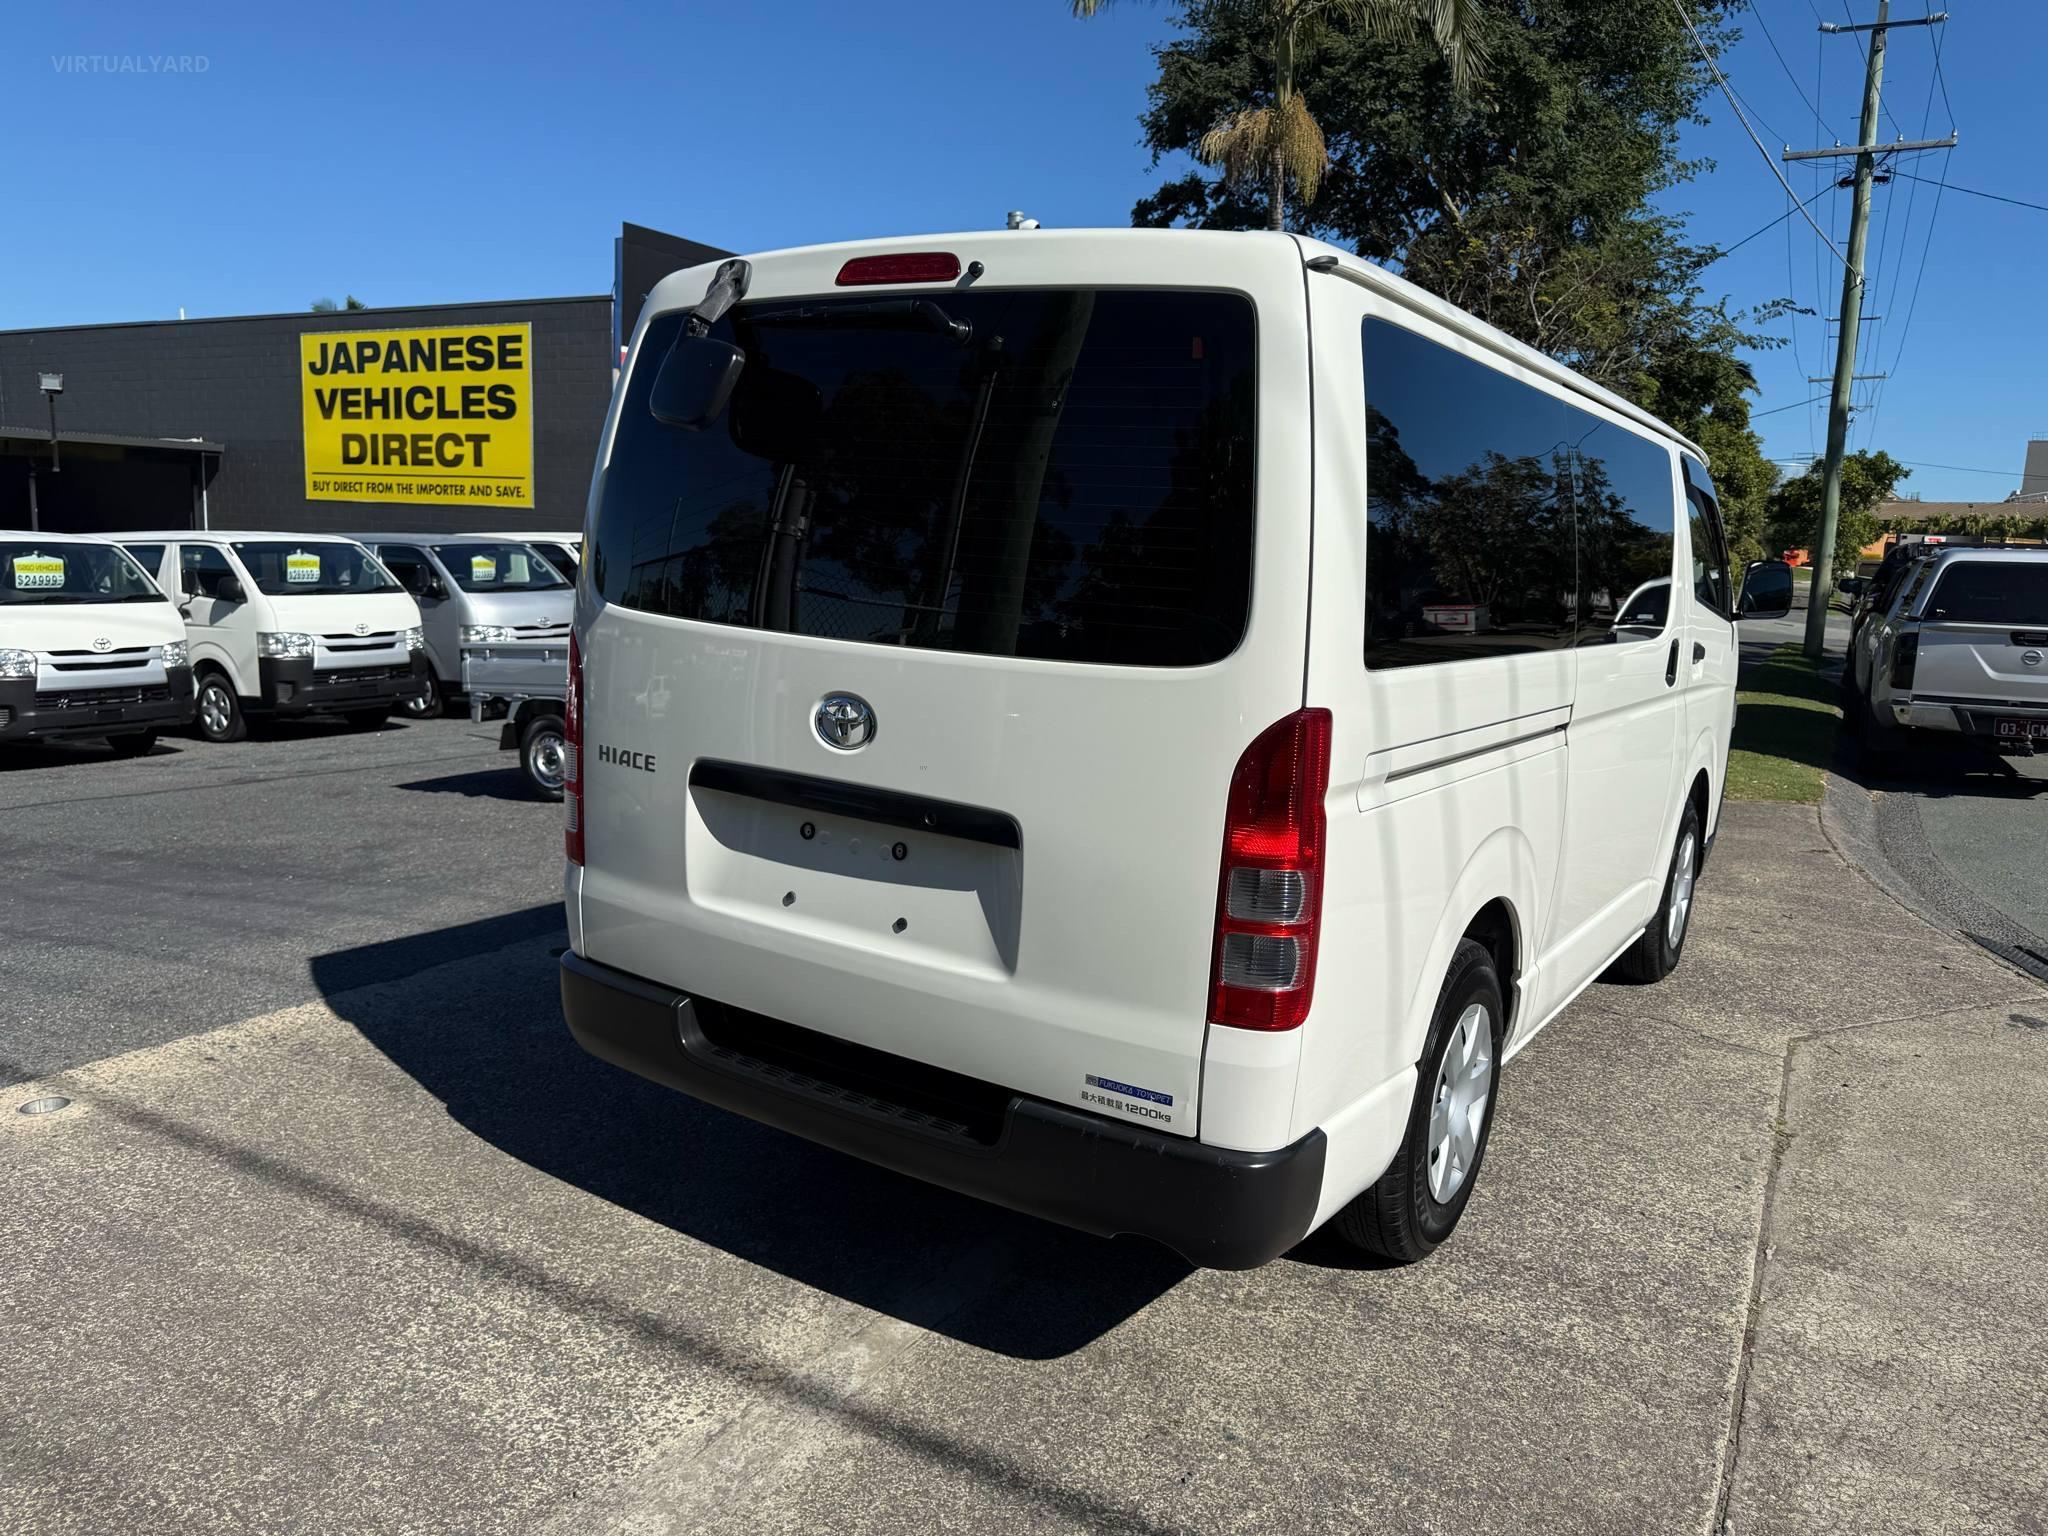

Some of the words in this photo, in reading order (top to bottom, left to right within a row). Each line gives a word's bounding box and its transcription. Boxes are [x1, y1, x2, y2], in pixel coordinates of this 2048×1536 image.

[308, 334, 523, 376] JAPANESE
[314, 384, 517, 421] VEHICLES
[341, 432, 491, 468] DIRECT
[312, 480, 331, 492] BUY
[334, 481, 363, 493] DIRECT
[366, 482, 394, 494] FROM
[397, 483, 414, 495] THE
[416, 483, 466, 496] IMPORTER
[469, 485, 492, 497] AND
[496, 486, 525, 499] SAVE.
[598, 744, 656, 773] HIACE
[1098, 1079, 1133, 1095] FUKUOKA
[1136, 1087, 1171, 1104] TOYOPET
[1124, 1102, 1172, 1123] 1200kg
